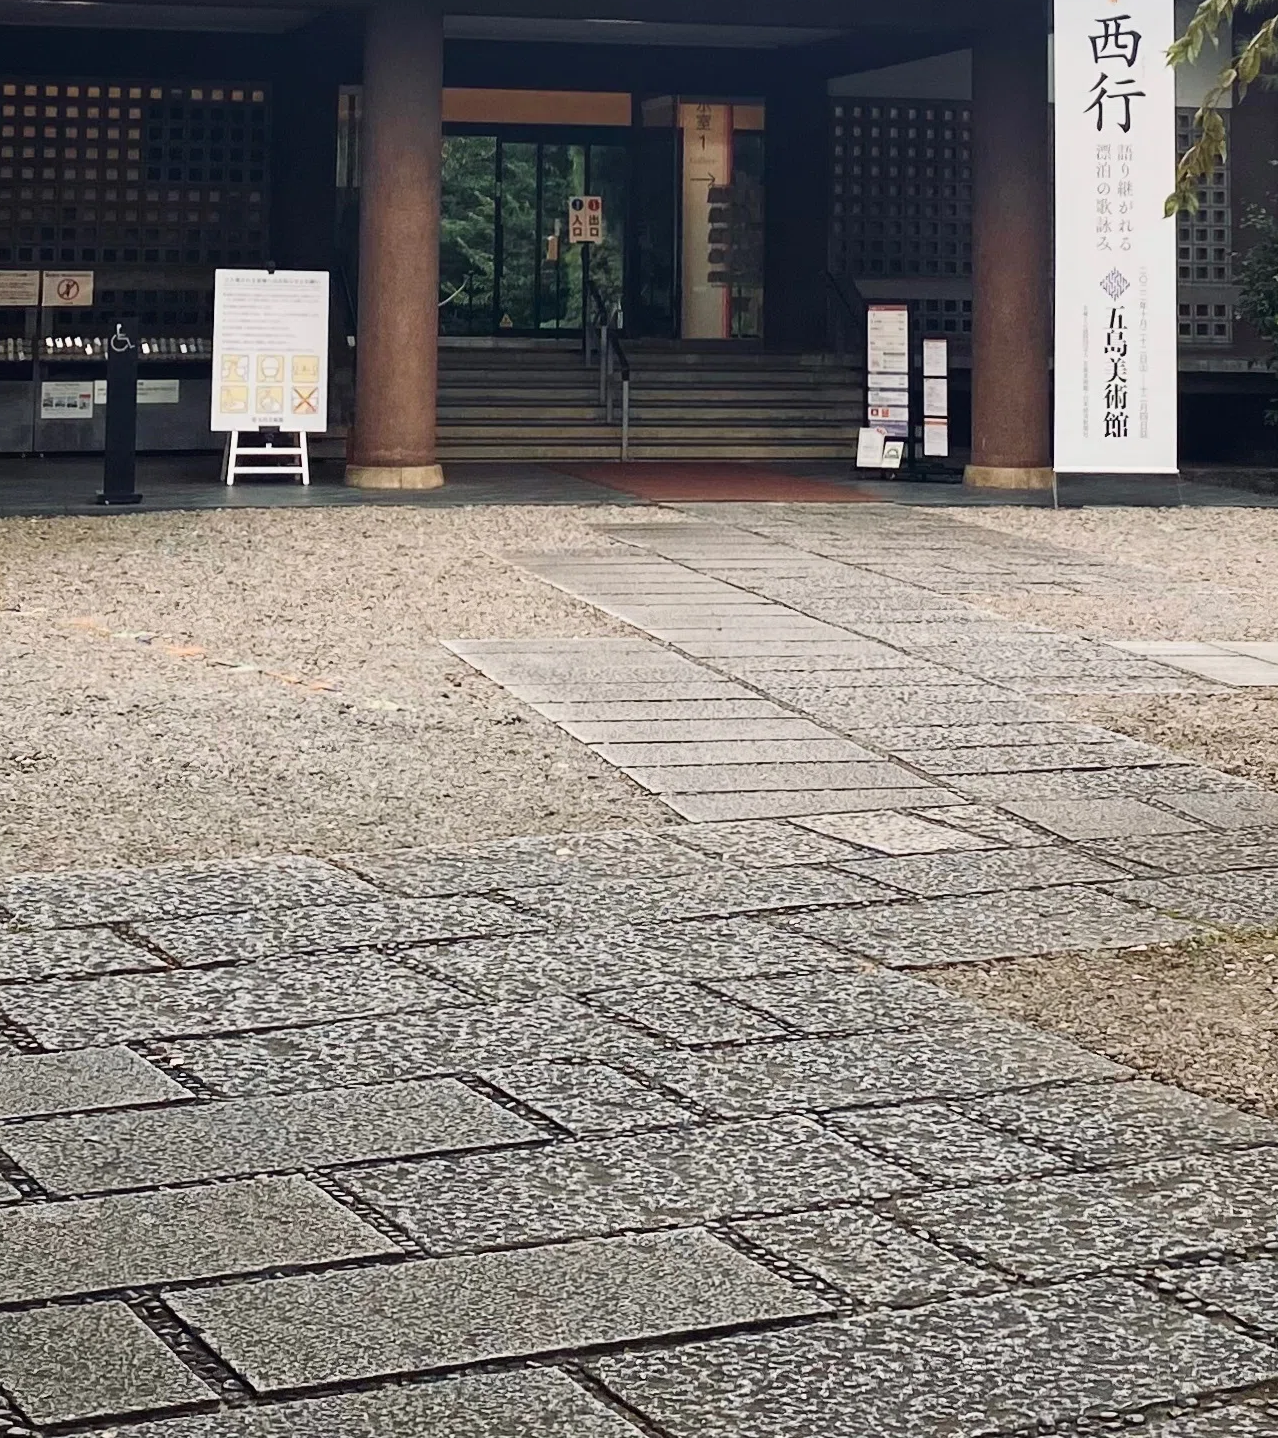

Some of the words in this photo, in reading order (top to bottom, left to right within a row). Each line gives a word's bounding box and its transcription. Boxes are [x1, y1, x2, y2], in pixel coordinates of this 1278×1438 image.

[1083, 14, 1146, 133] 西行
[572, 214, 582, 237] 入口
[588, 214, 599, 237] 出口
[1096, 144, 1112, 251] 漂泊の歌詠み
[1118, 144, 1133, 251] 語り継がれる
[1103, 305, 1128, 438] 五島美術館
